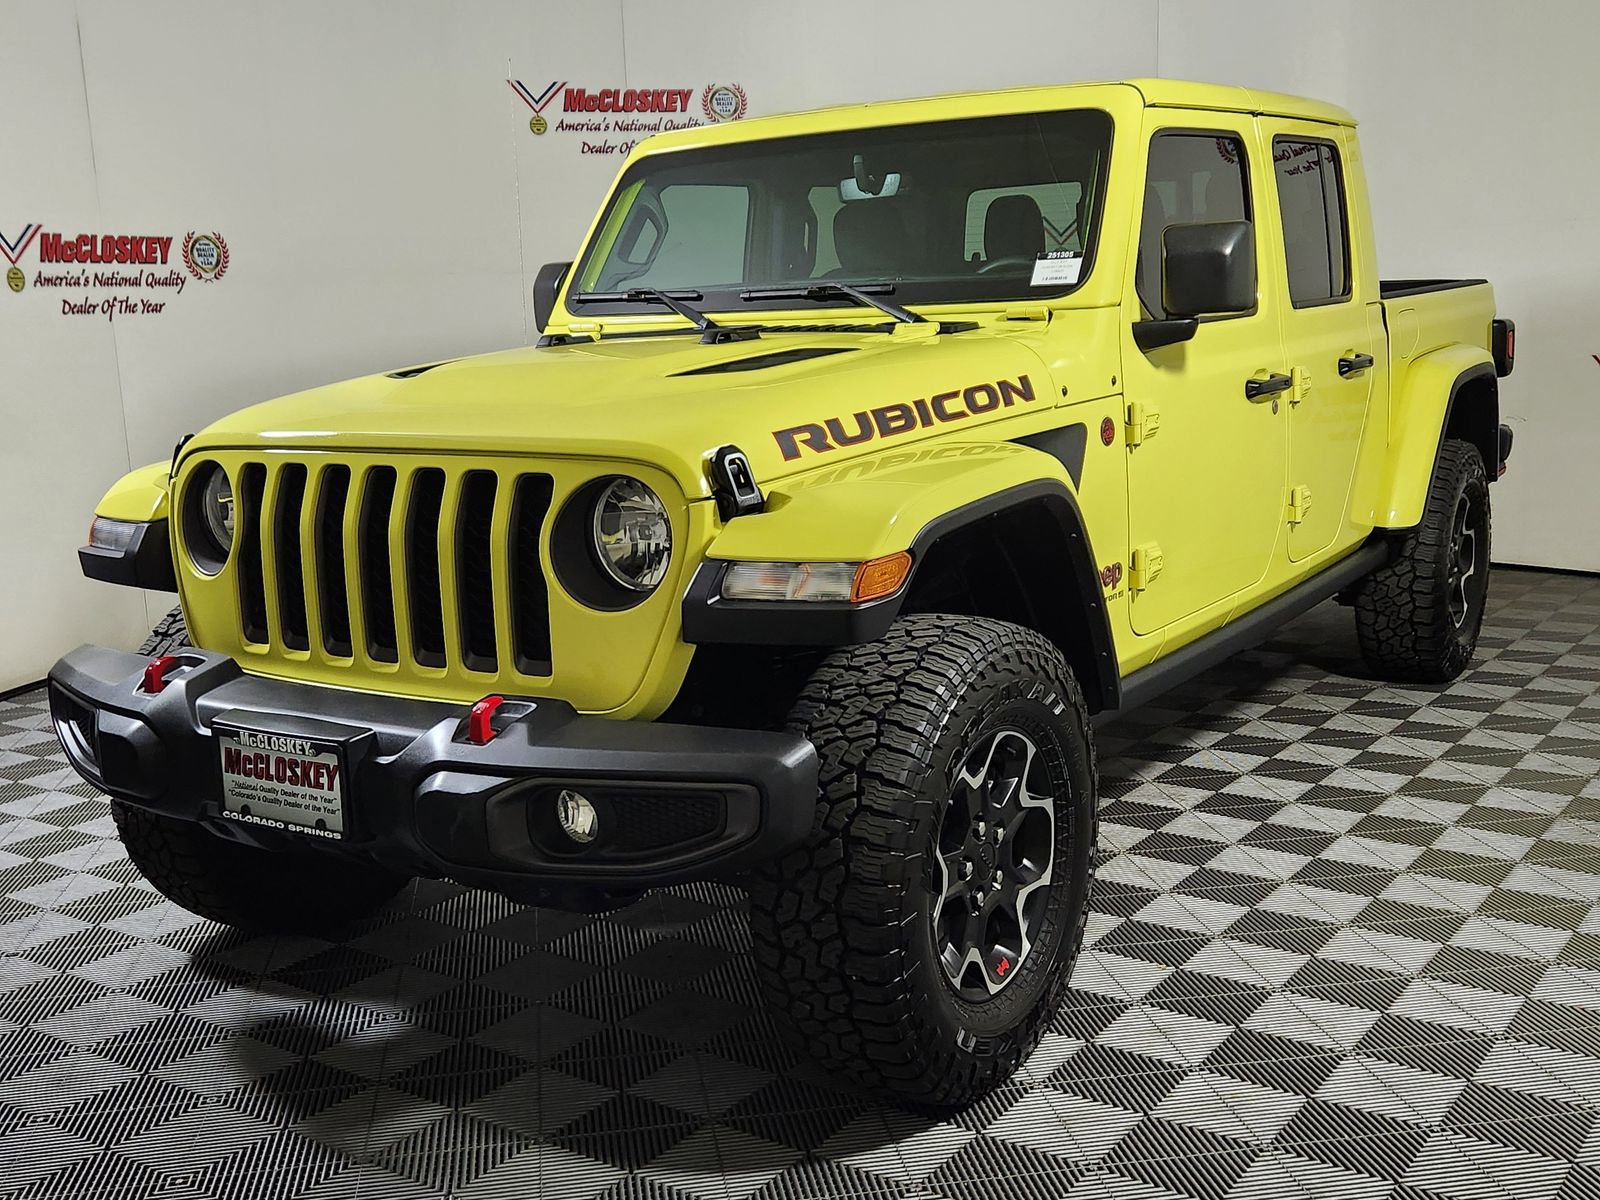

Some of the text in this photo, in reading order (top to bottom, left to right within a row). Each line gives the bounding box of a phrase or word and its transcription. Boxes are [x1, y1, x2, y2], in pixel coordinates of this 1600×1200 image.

[563, 88, 693, 113] McCLOSKEY
[555, 117, 610, 132] America's
[613, 116, 662, 132] National
[581, 140, 617, 155] Dealer
[40, 232, 173, 265] McCLOSKEY
[1047, 251, 1075, 259] 251305
[33, 269, 89, 288] America's
[93, 270, 142, 288] National
[145, 271, 187, 294] Quality
[62, 296, 166, 322] Dealer Of The Year
[771, 374, 1036, 462] RUBICON
[240, 732, 312, 756] McCLOSKEY
[224, 747, 339, 792] McCLOSKEY
[260, 784, 280, 796] Quality
[280, 789, 300, 800] Dealer
[308, 794, 319, 802] the
[262, 795, 283, 807] Quality
[283, 799, 303, 809] Dealer
[304, 802, 311, 810] of
[311, 804, 322, 812] the
[222, 811, 341, 840] COLORADO SPRINGS
